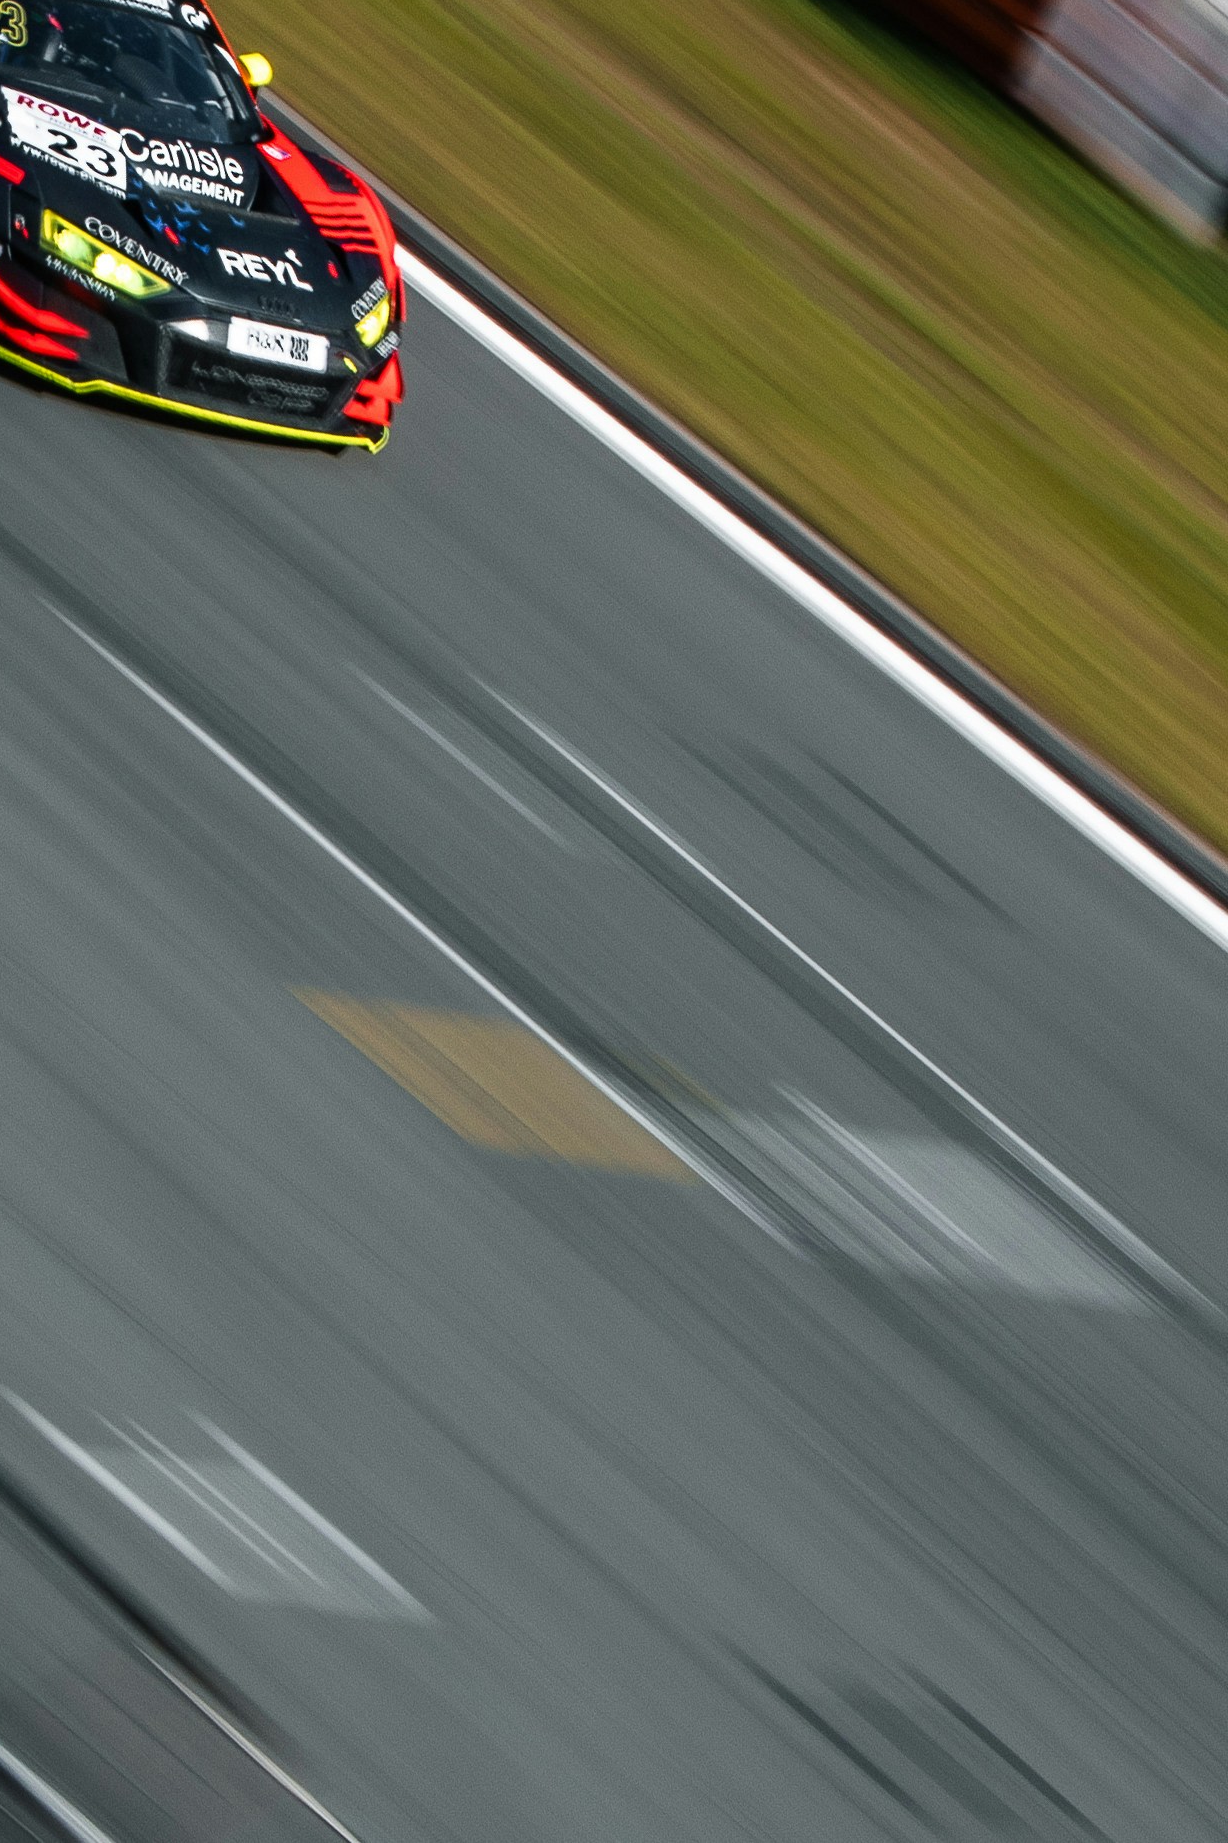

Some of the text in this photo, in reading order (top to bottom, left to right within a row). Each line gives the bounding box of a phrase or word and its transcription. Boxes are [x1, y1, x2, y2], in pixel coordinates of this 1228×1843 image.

[16, 94, 107, 138] ROWE
[47, 128, 118, 178] 23
[119, 127, 245, 185] Carlisle
[84, 216, 190, 286] COVENTRY
[217, 247, 314, 293] REYL
